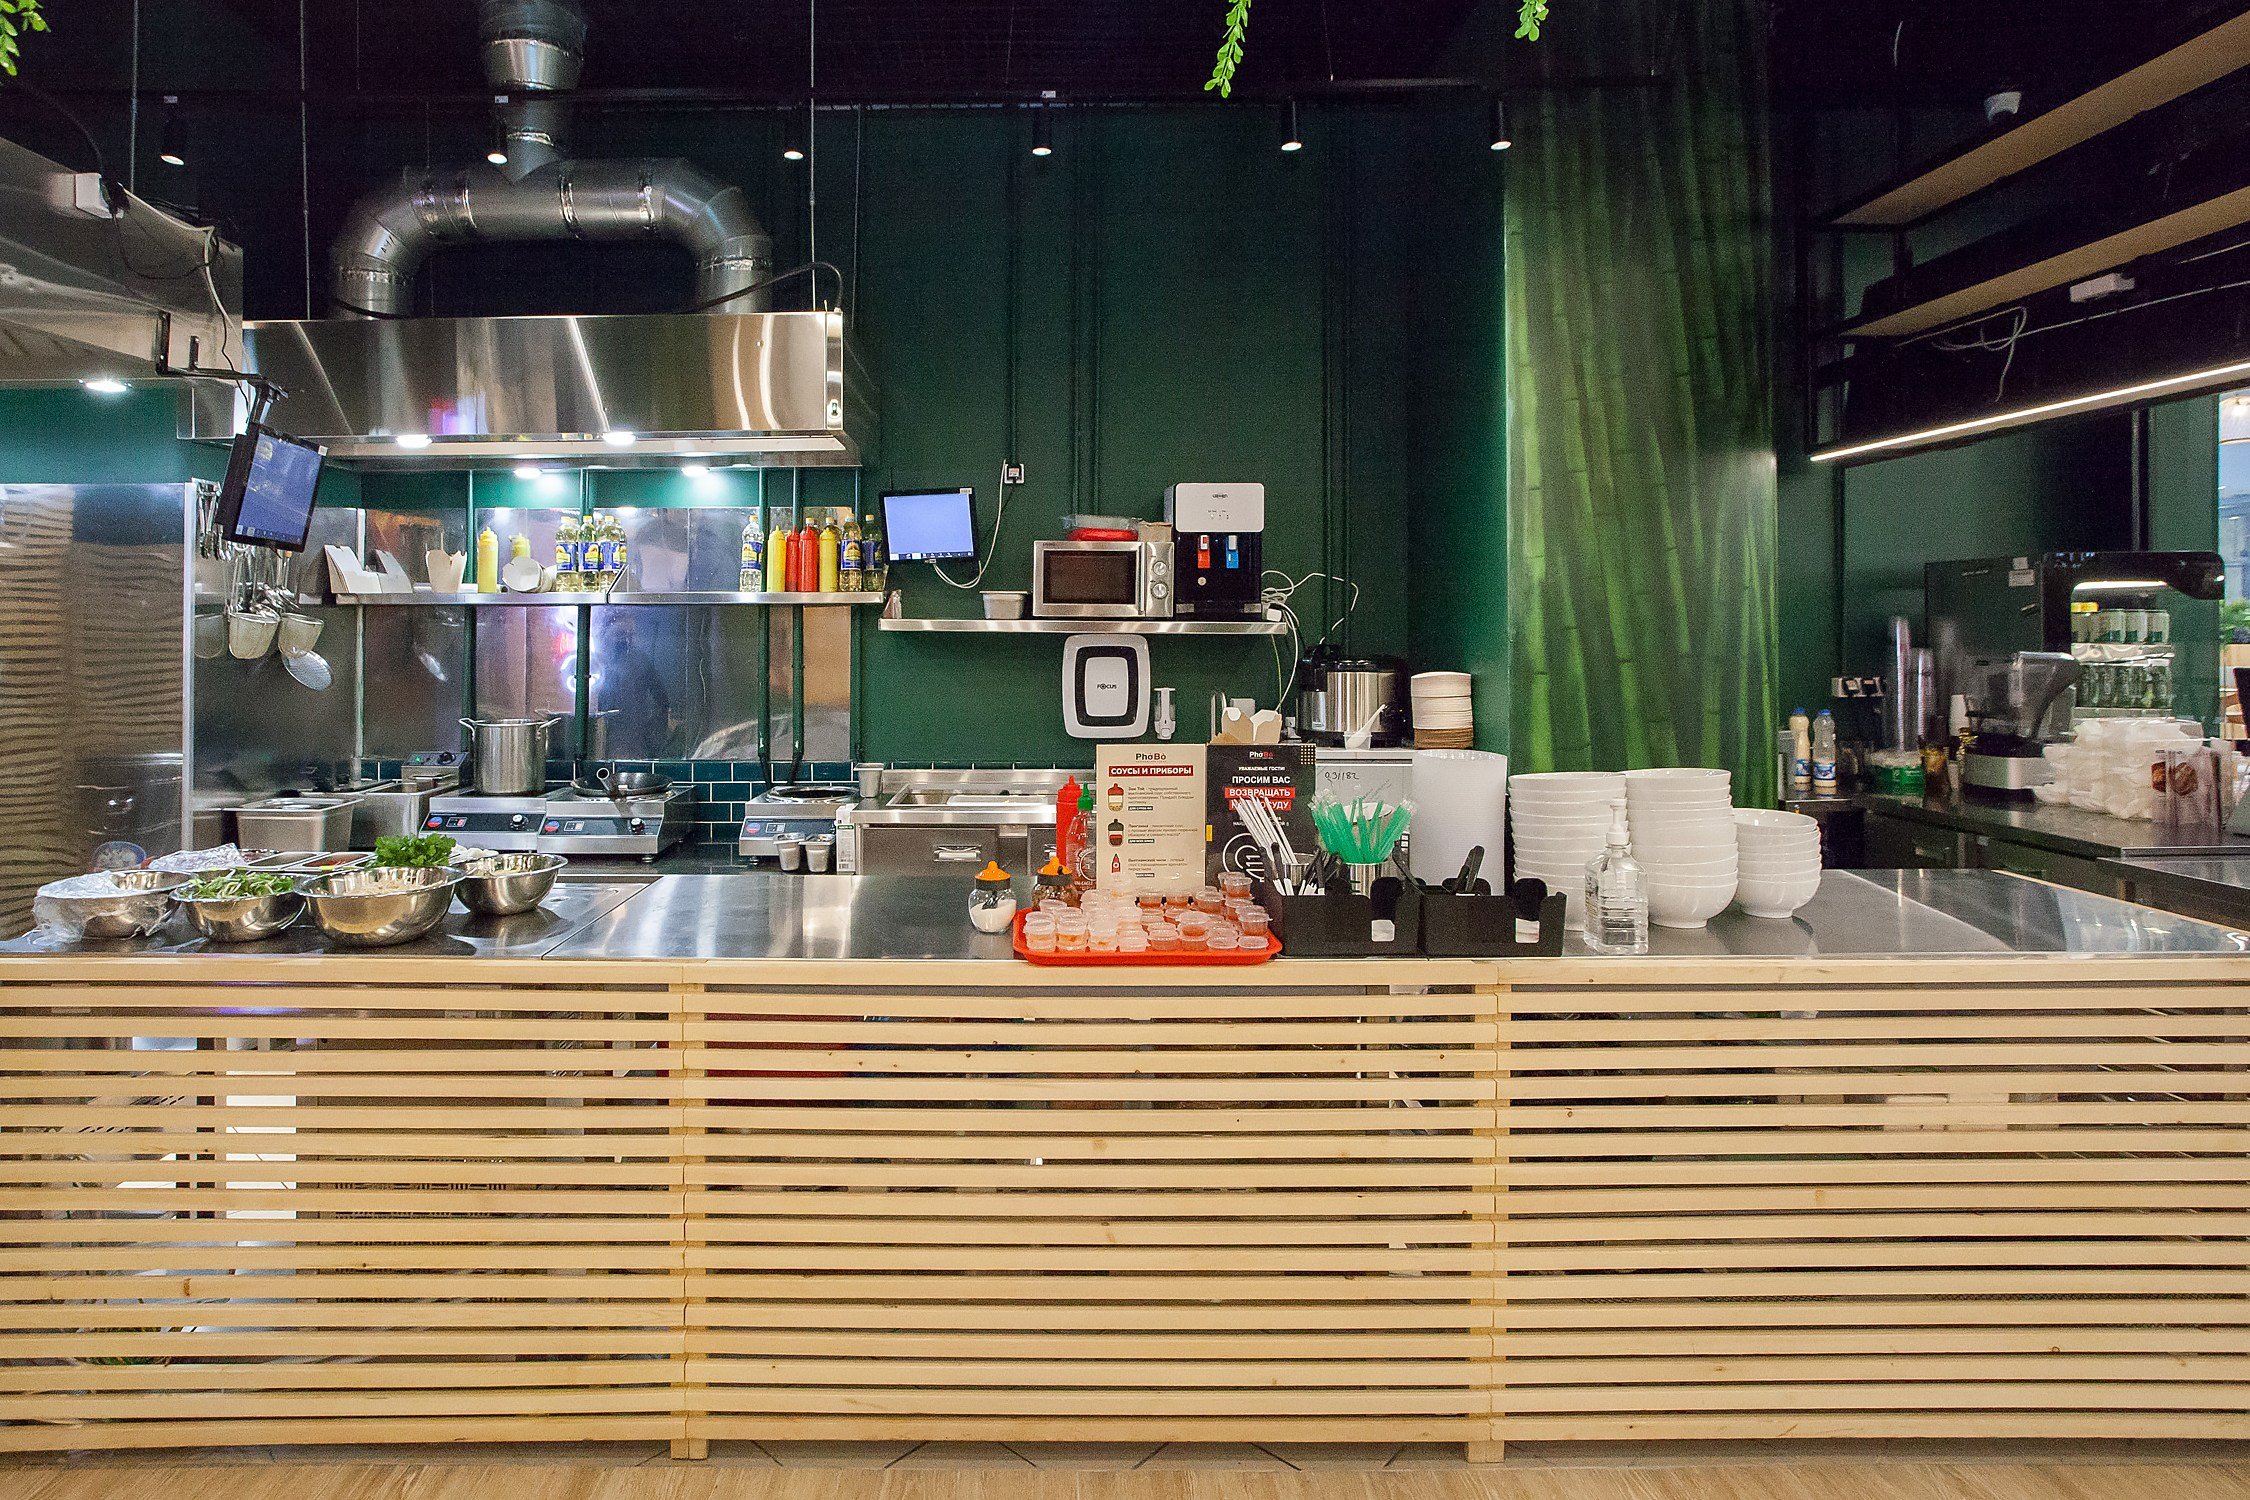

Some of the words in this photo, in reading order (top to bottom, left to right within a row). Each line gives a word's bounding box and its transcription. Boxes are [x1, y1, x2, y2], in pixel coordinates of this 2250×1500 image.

[1232, 776, 1270, 784] ПРОСИМ
[1272, 776, 1291, 784] ВАС
[1229, 788, 1291, 797] ВОЗВРАЩАТЬ
